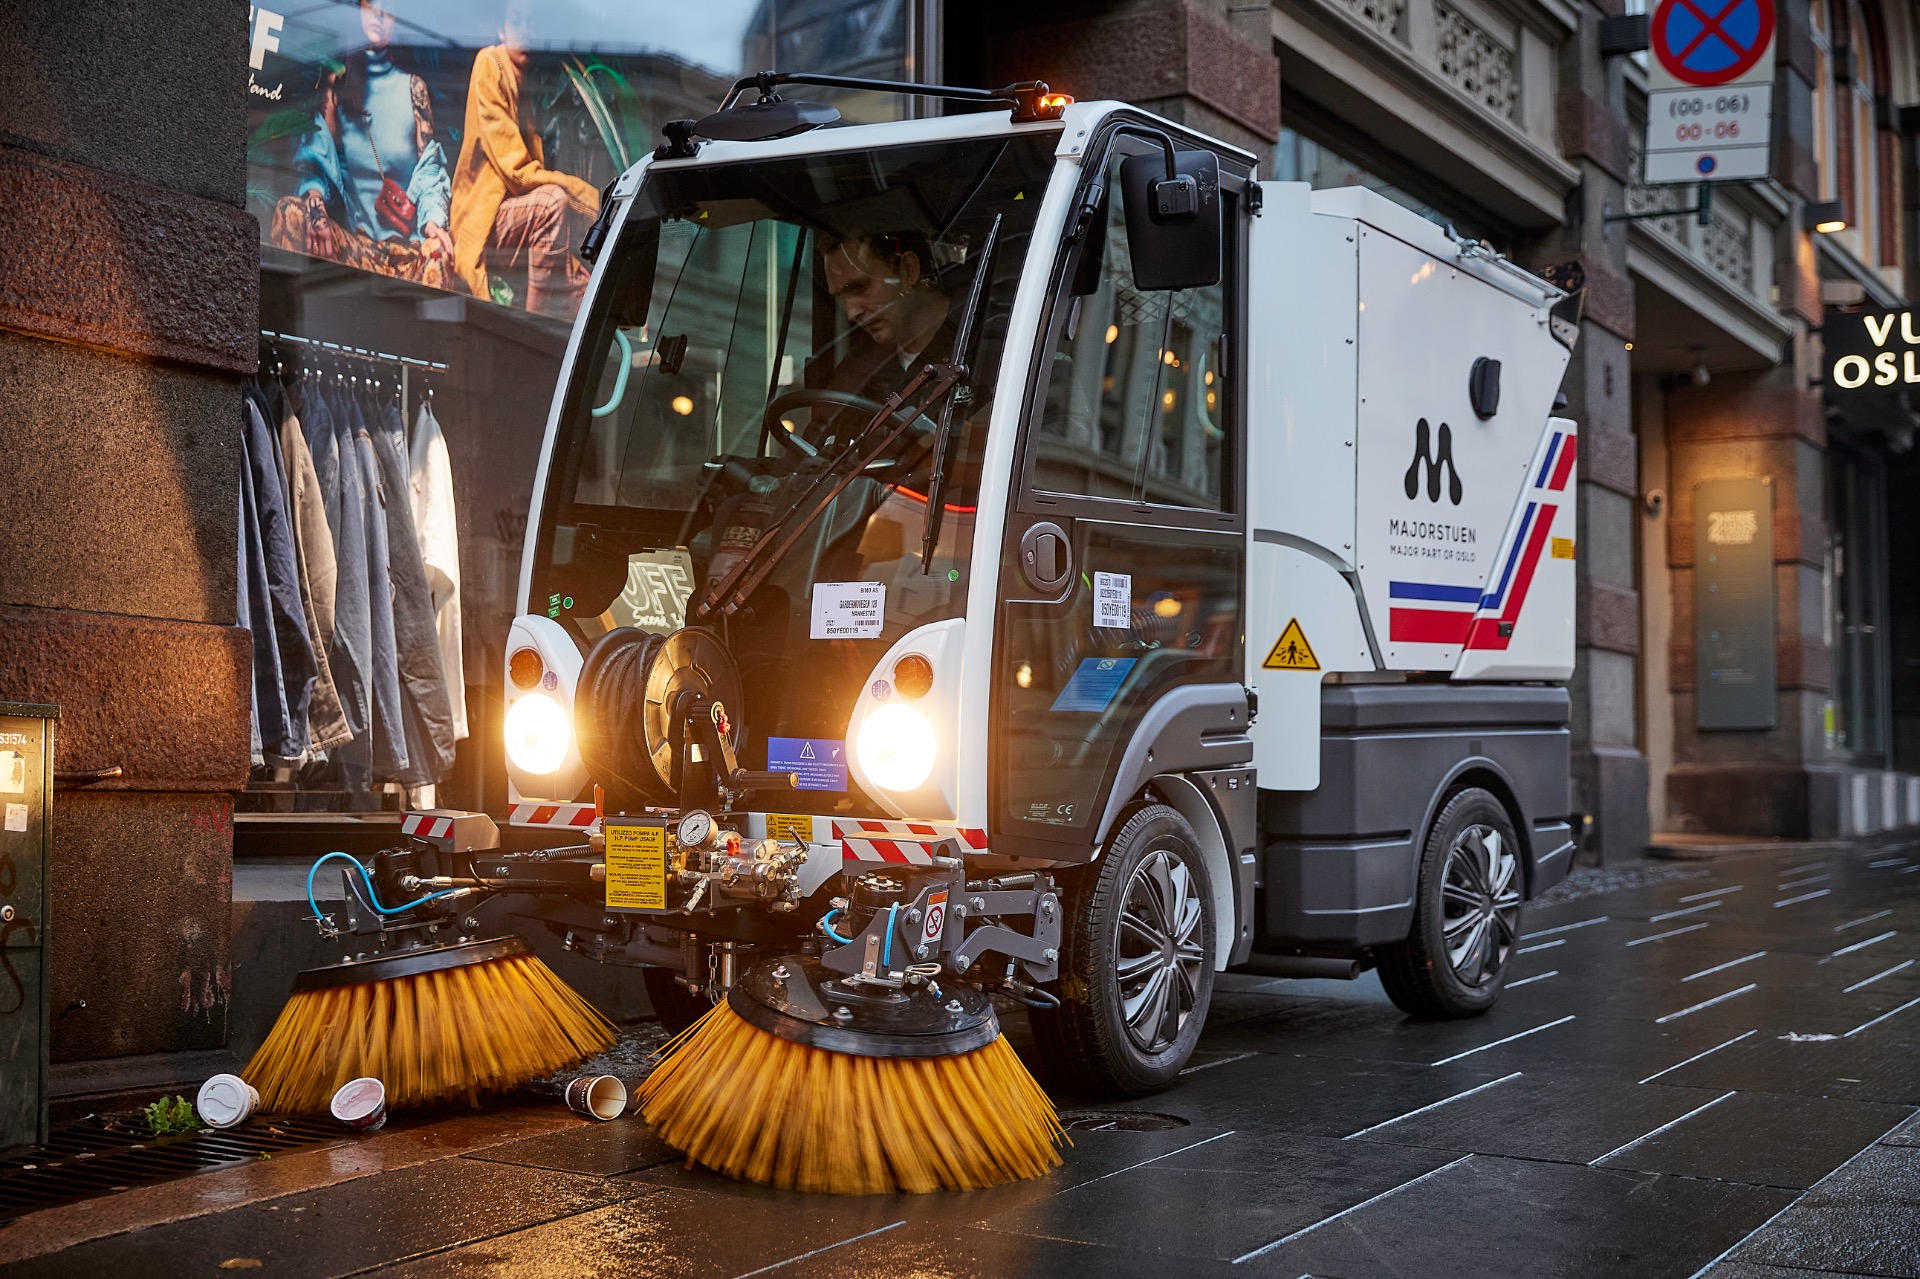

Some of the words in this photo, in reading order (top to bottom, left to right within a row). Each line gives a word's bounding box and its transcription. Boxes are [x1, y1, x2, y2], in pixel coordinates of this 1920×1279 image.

[1389, 519, 1477, 544] MAJORSTUEN
[1389, 545, 1419, 557] MAJOR
[1421, 547, 1442, 559] PART
[1444, 550, 1454, 560] OF
